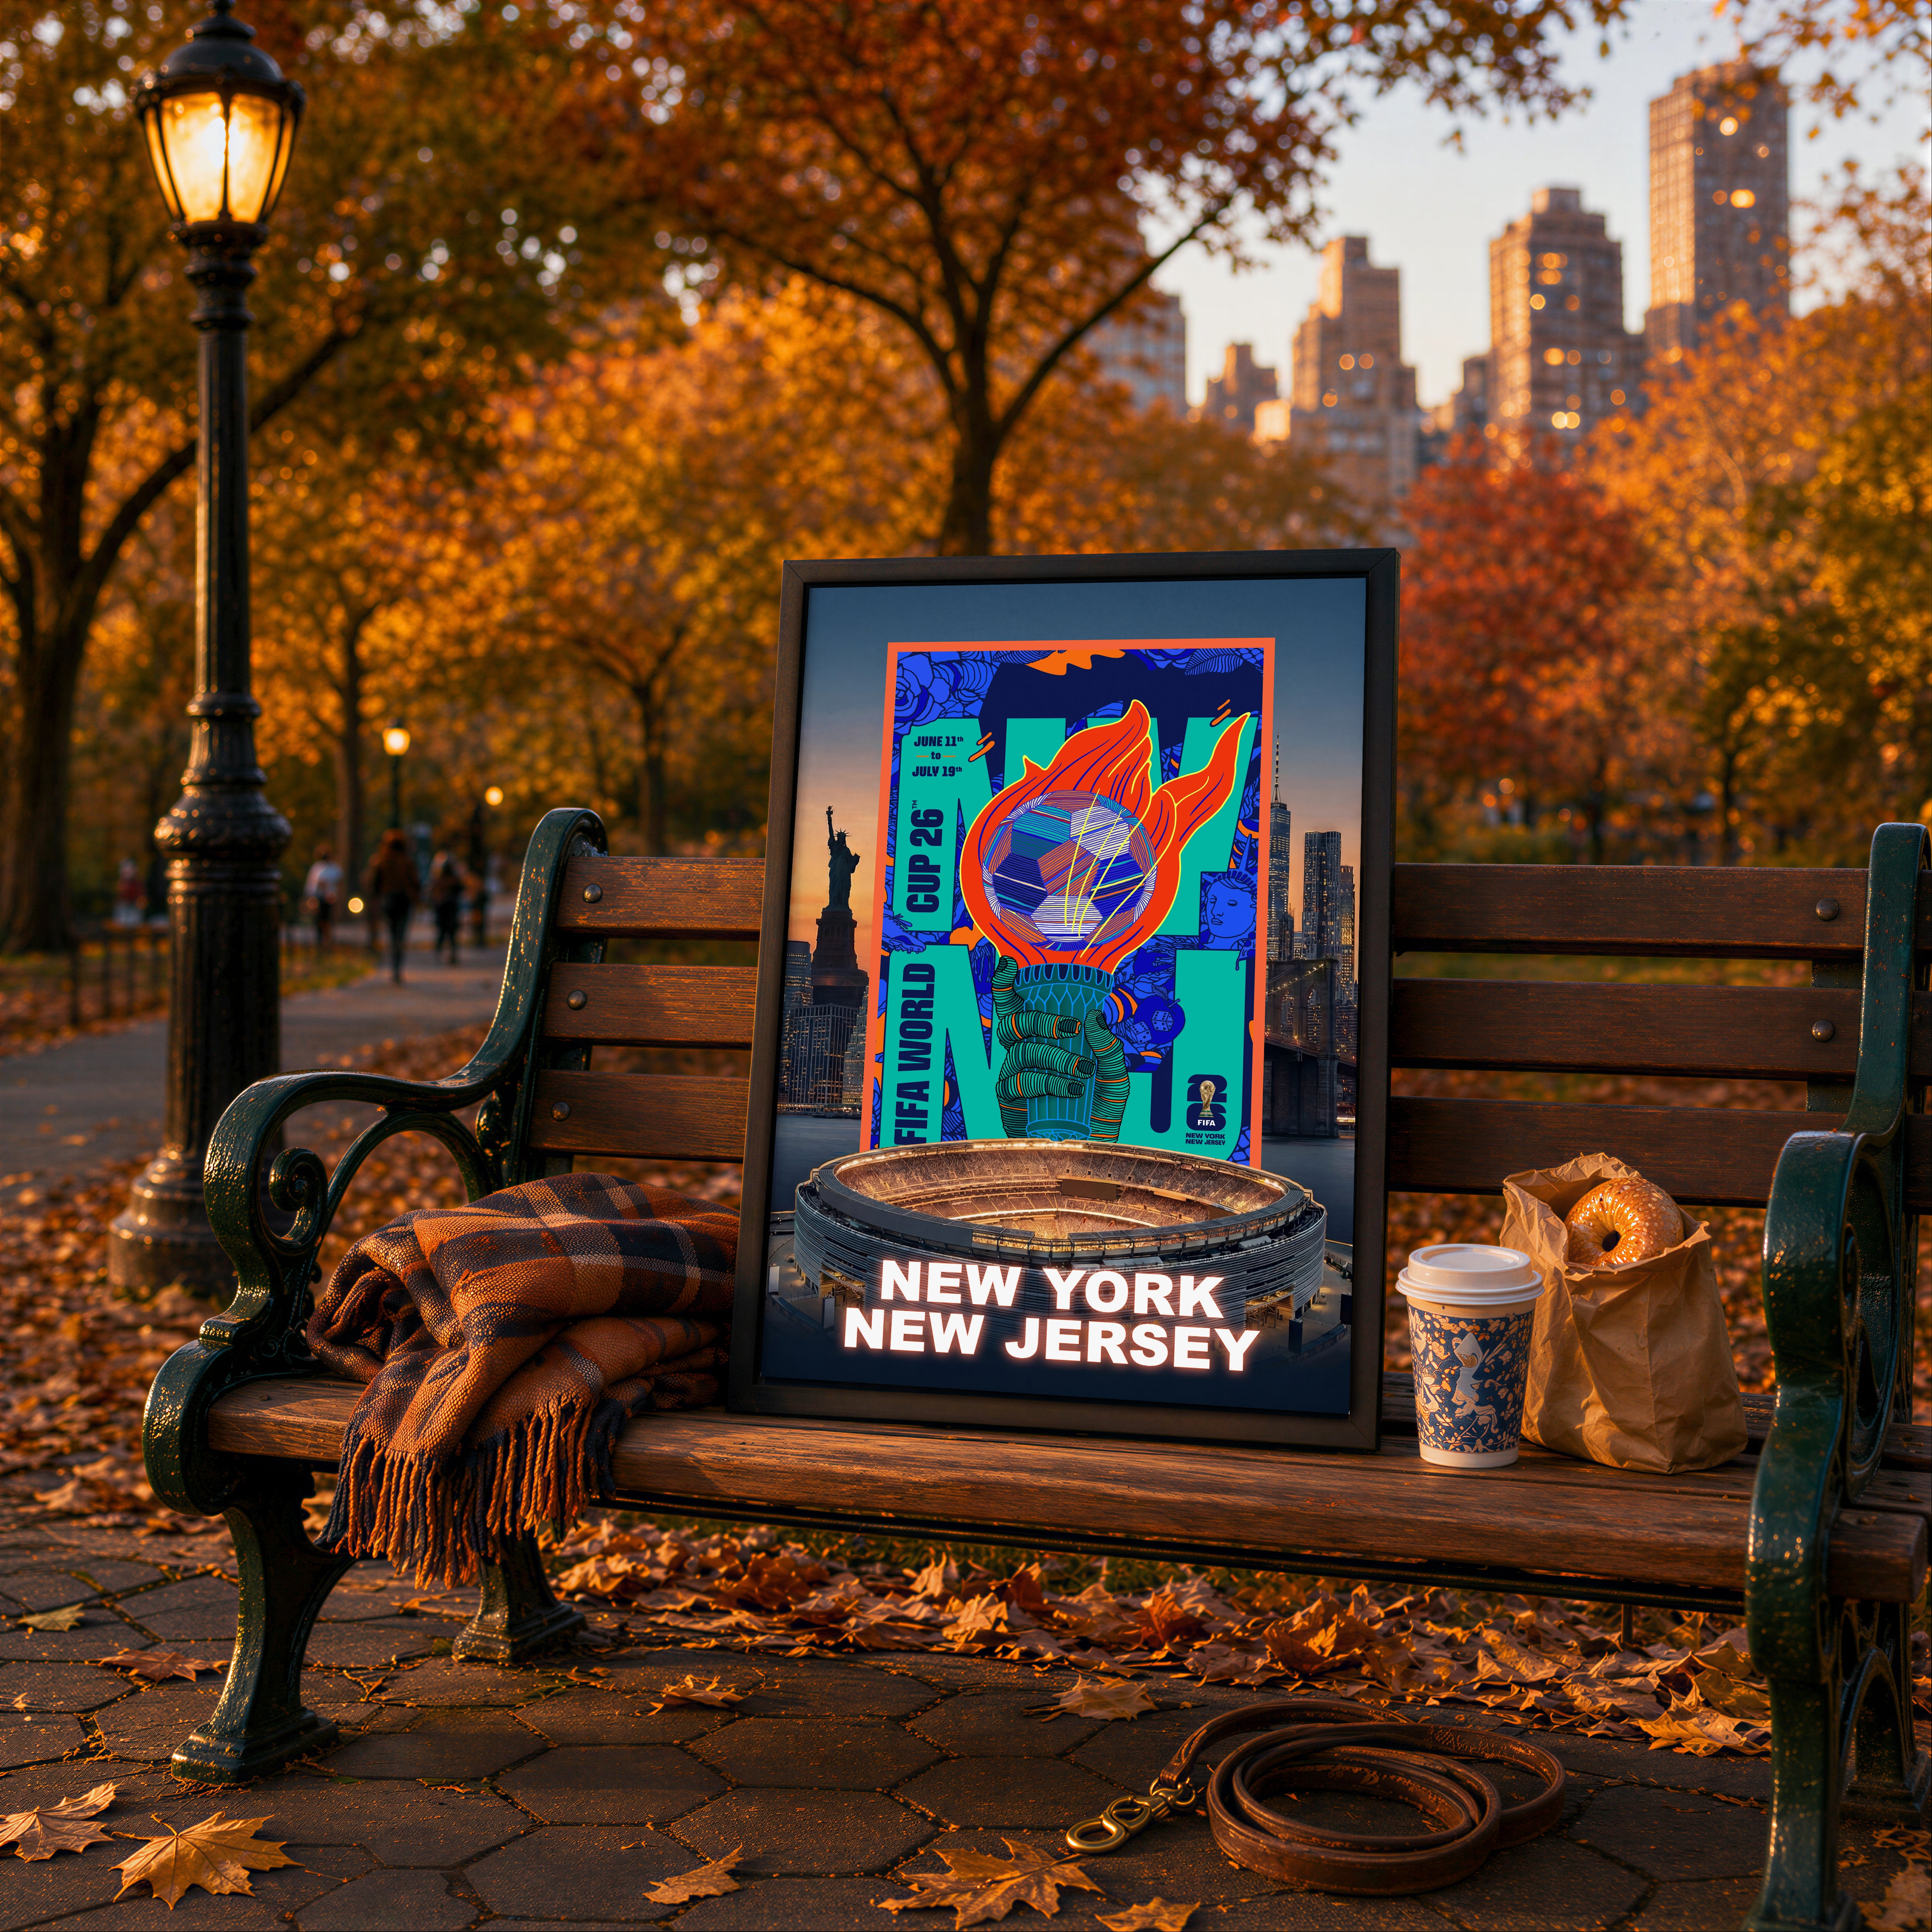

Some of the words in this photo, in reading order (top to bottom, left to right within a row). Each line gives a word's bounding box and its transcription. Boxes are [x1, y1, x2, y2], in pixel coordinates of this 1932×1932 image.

[914, 736, 943, 747] JUNE
[945, 736, 964, 746] 11th
[931, 751, 941, 760] to
[912, 766, 939, 777] JULY
[942, 766, 962, 777] 19th
[906, 854, 941, 913] CUP
[897, 963, 935, 1072] WORLD
[894, 1080, 930, 1145] FIFA
[880, 1259, 1022, 1306] NEW
[1043, 1268, 1224, 1318] YORK
[844, 1307, 984, 1354] NEW
[1005, 1317, 1260, 1371] JERSEY
